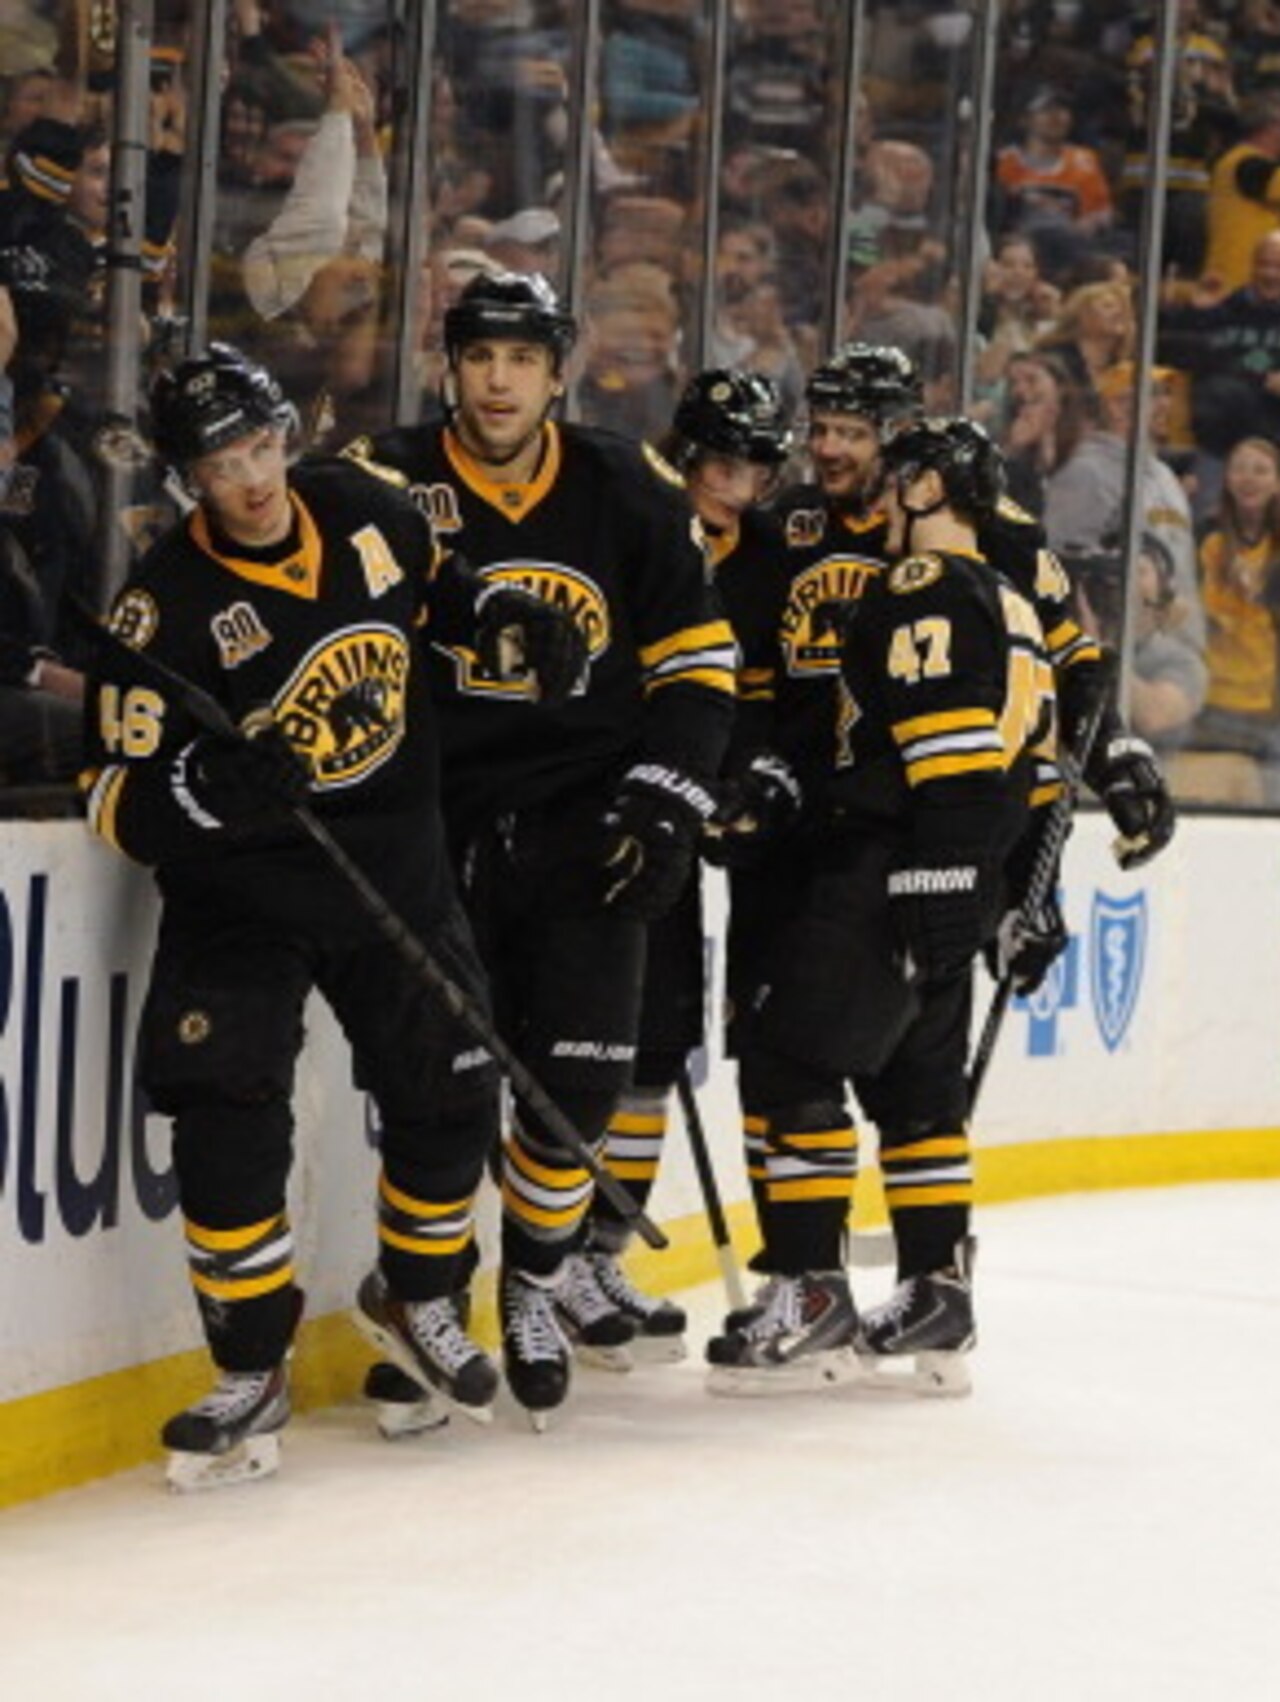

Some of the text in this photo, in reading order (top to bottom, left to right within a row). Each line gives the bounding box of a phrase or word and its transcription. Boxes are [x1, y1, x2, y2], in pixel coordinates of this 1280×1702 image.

[350, 522, 404, 599] A
[888, 616, 952, 684] 47
[279, 640, 404, 746] BRUINS
